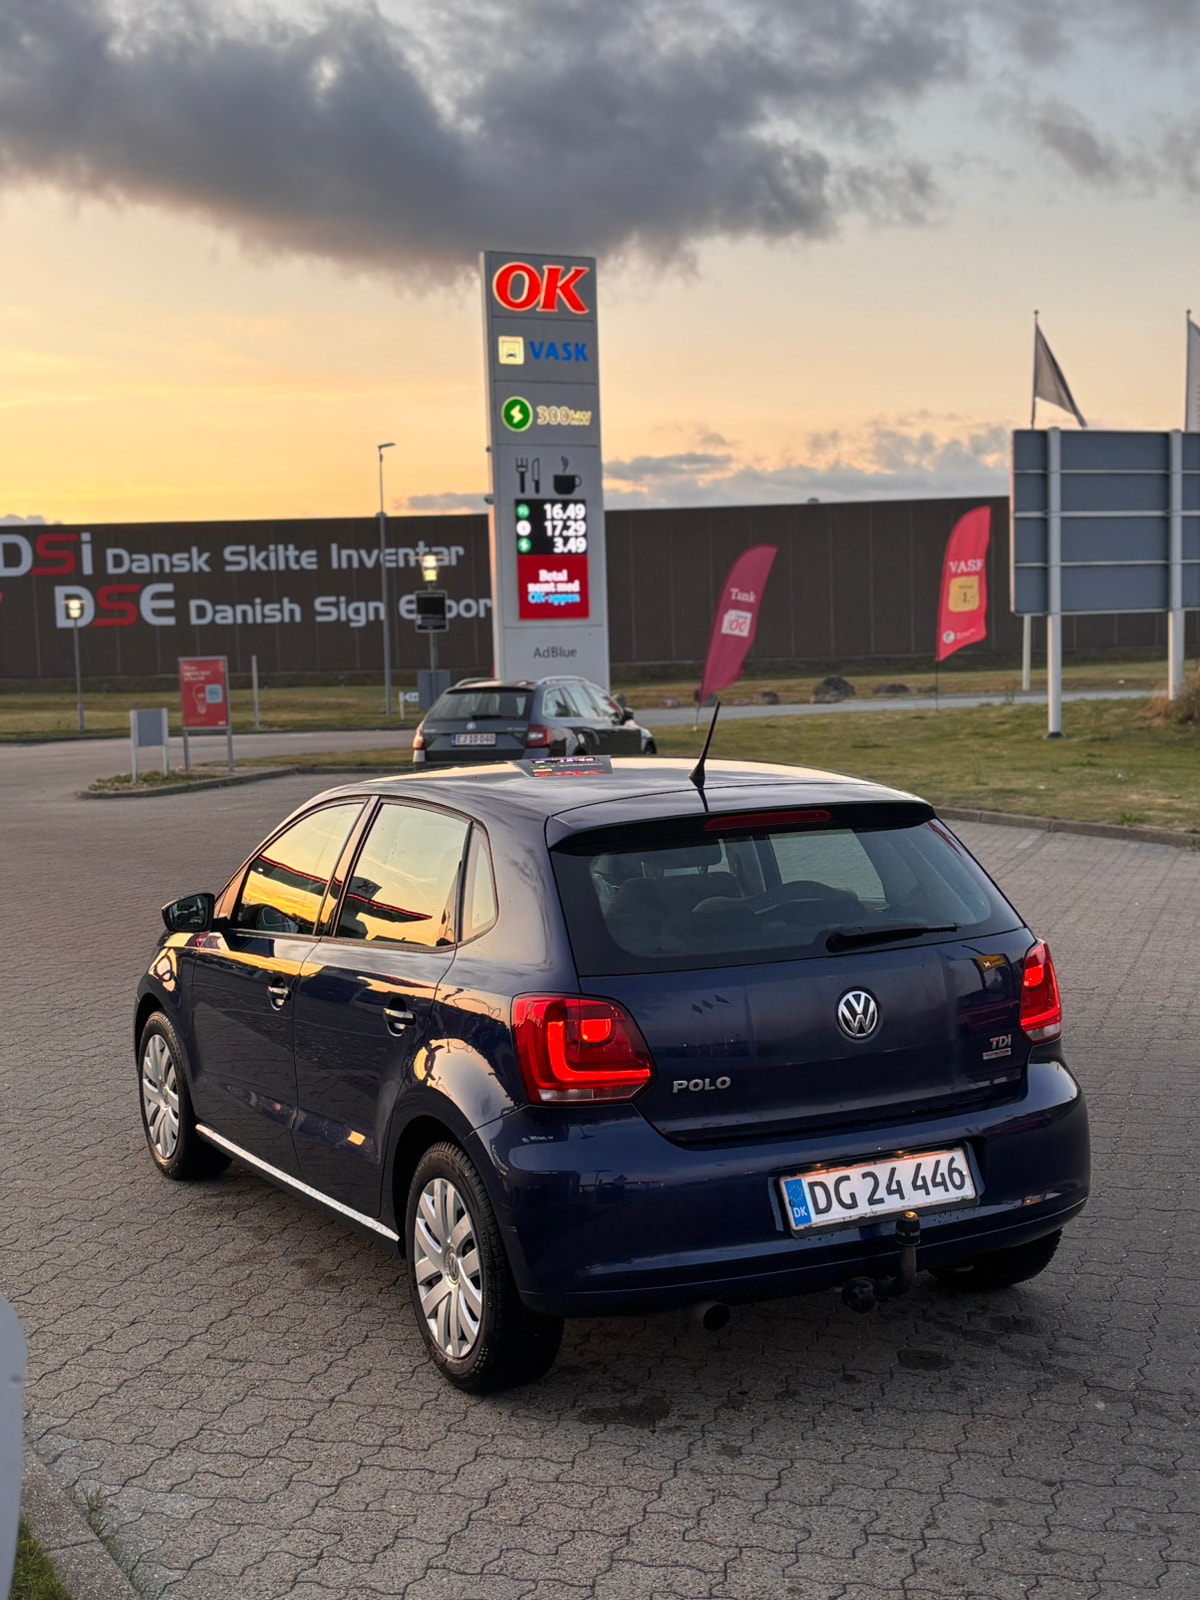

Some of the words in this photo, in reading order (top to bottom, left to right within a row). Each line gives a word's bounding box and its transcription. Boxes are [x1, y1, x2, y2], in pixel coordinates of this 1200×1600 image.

[492, 262, 589, 314] OK
[529, 341, 588, 362] VASK
[543, 503, 586, 520] 16.49
[543, 520, 587, 537] 17.29
[553, 537, 587, 553] 3.49
[106, 546, 211, 574] Dansk
[223, 543, 318, 572] Skilte
[331, 541, 464, 569] Inventar
[54, 583, 176, 629] DSE
[189, 597, 301, 625] Danish
[314, 596, 385, 627] Sign
[533, 646, 577, 659] AdBlue
[672, 1076, 732, 1094] POLO
[808, 1175, 859, 1215] DG
[861, 1167, 905, 1207] 24
[911, 1156, 966, 1197] 446
[793, 1206, 808, 1219] DK
